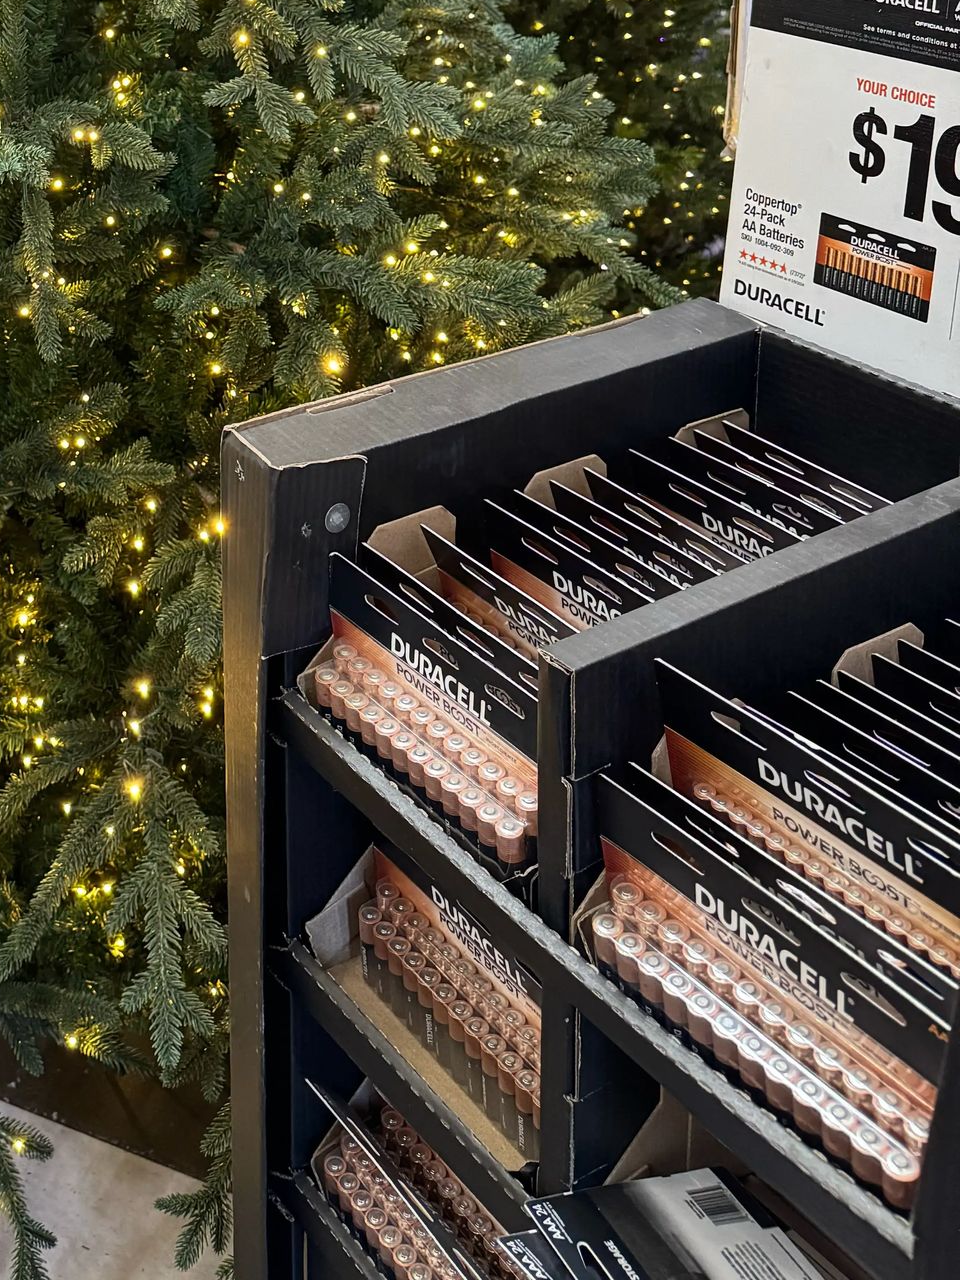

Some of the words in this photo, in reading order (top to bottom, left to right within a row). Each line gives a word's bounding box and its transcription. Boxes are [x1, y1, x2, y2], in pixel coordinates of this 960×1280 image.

[862, 23, 876, 33] See
[876, 26, 896, 37] terms
[897, 31, 911, 40] and
[911, 34, 949, 48] conditions
[914, 20, 945, 32] OFFICIAL
[856, 77, 888, 98] YOUR
[890, 86, 937, 109] CHOICE
[743, 203, 787, 228] 24-Pack
[740, 232, 753, 243] SKU
[742, 218, 757, 234] AA
[759, 224, 806, 250] Batteries
[850, 235, 900, 260] DURACELL
[851, 247, 875, 260] POWER
[875, 255, 895, 266] BOOST
[733, 278, 824, 327] DURACELL
[391, 631, 491, 727] DURACELL
[395, 662, 441, 708] POWER
[442, 700, 480, 737] BOOST
[757, 757, 924, 885] DURACELL
[771, 806, 845, 867] POWER
[848, 856, 912, 908] BOOST
[430, 884, 528, 994] DURACELL
[694, 882, 855, 1023] DURACELL
[439, 911, 482, 959] POWER
[483, 960, 520, 1000] BOOST
[531, 1203, 549, 1218] 24
[542, 1217, 566, 1241] AAA
[506, 1240, 523, 1255] 24
[603, 1239, 640, 1280] STORAGE
